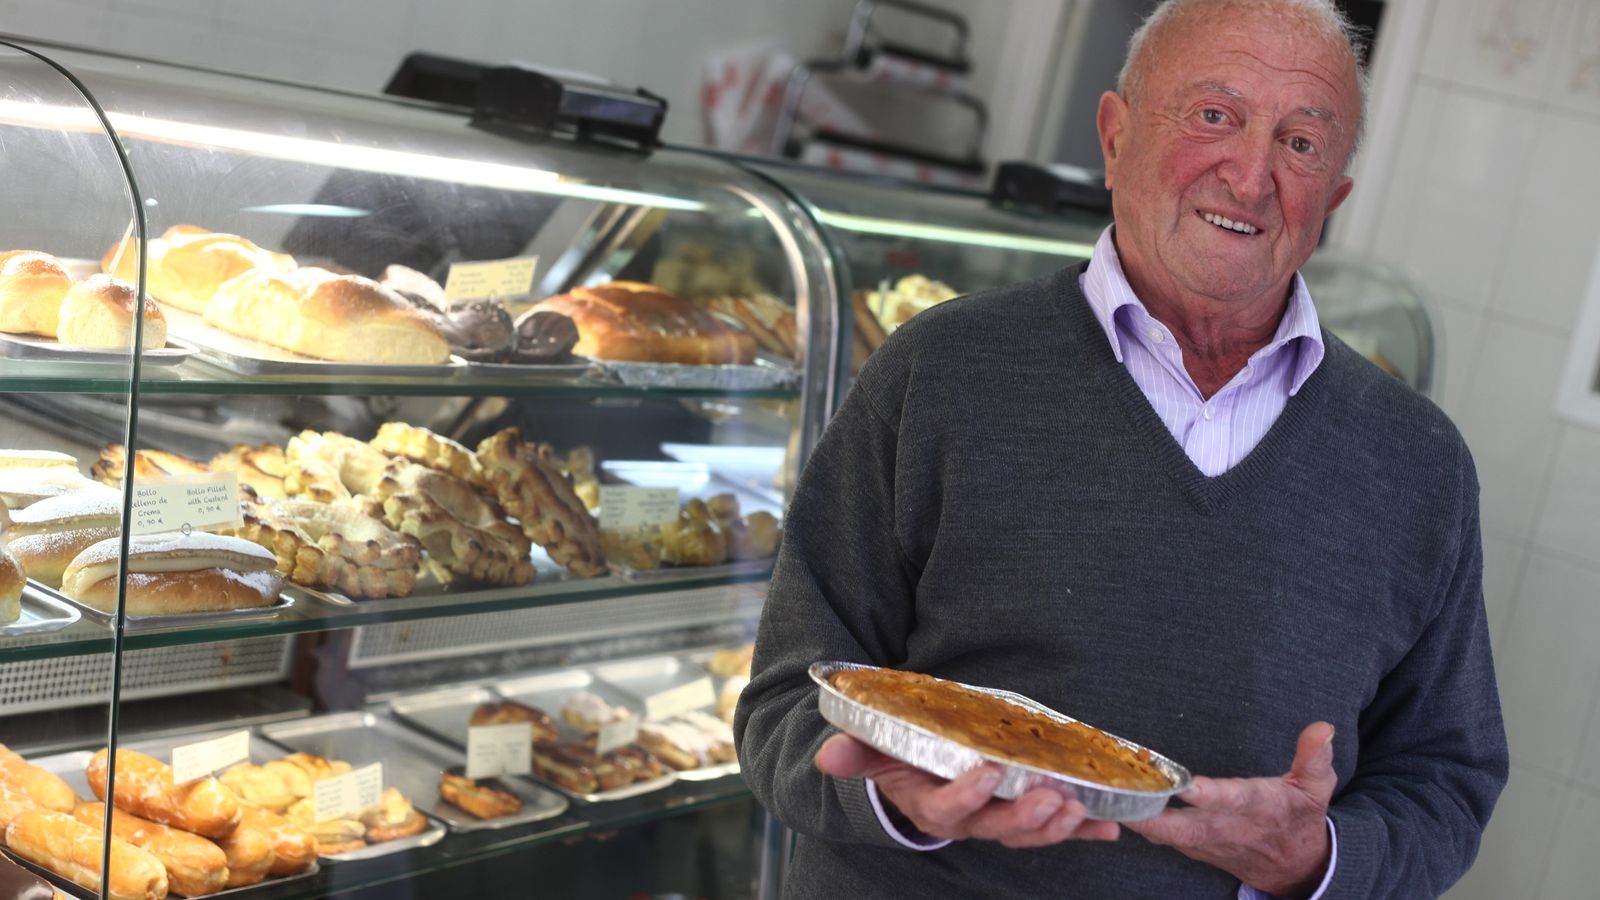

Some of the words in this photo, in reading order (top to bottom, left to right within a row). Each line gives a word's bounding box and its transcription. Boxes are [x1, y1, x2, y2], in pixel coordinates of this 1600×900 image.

[137, 489, 157, 498] Bollo
[187, 488, 205, 496] Bollo
[207, 484, 227, 493] Filled
[203, 494, 228, 503] Custard
[138, 509, 161, 517] Crema
